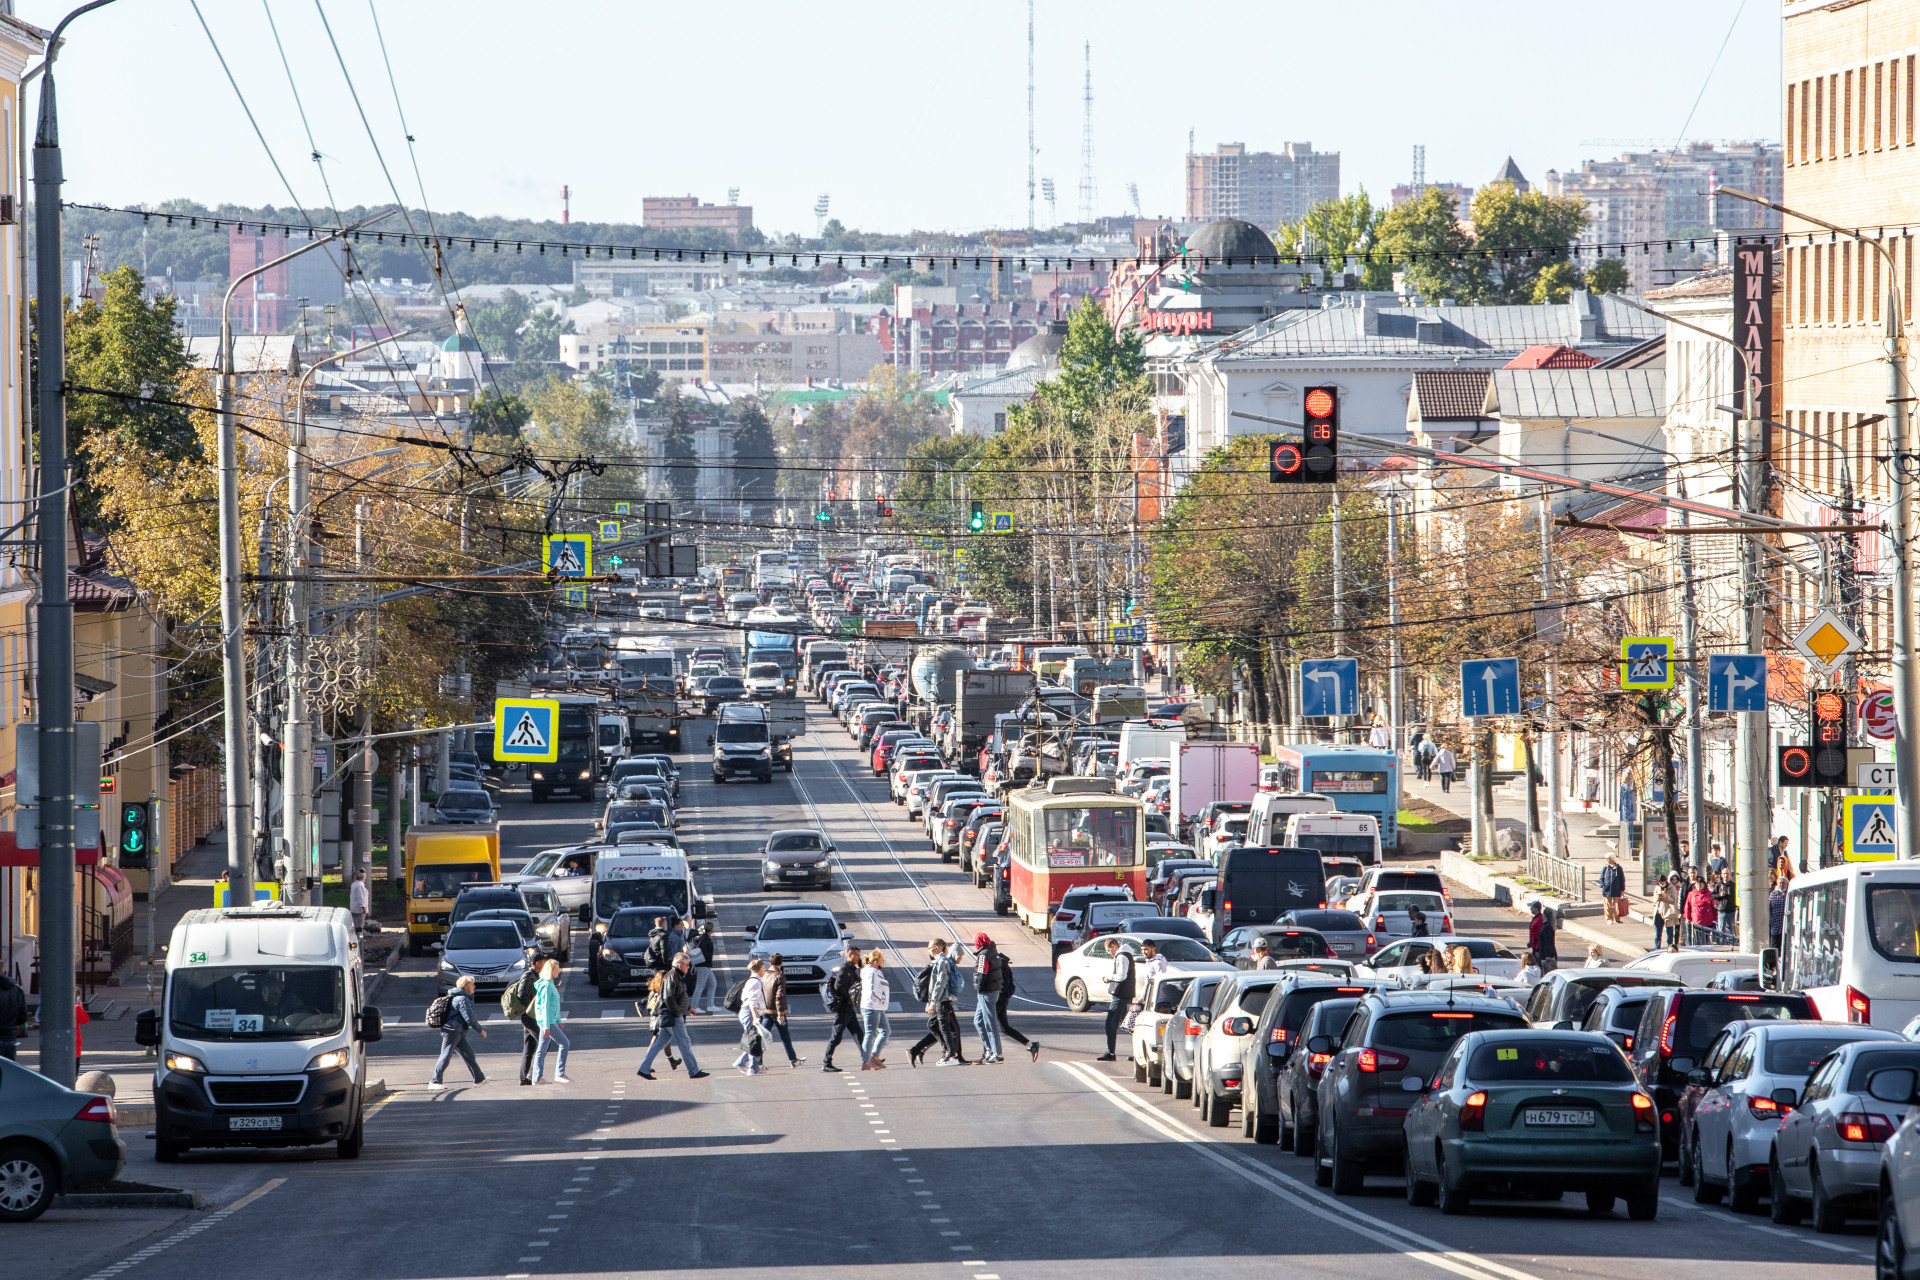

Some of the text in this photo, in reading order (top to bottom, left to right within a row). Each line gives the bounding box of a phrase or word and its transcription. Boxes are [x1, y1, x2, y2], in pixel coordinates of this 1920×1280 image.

[1313, 424, 1331, 439] 26
[1871, 768, 1896, 784] СТ
[127, 810, 136, 822] 2
[1115, 871, 1124, 879] 12
[189, 952, 207, 963] 34
[238, 1019, 258, 1032] 34
